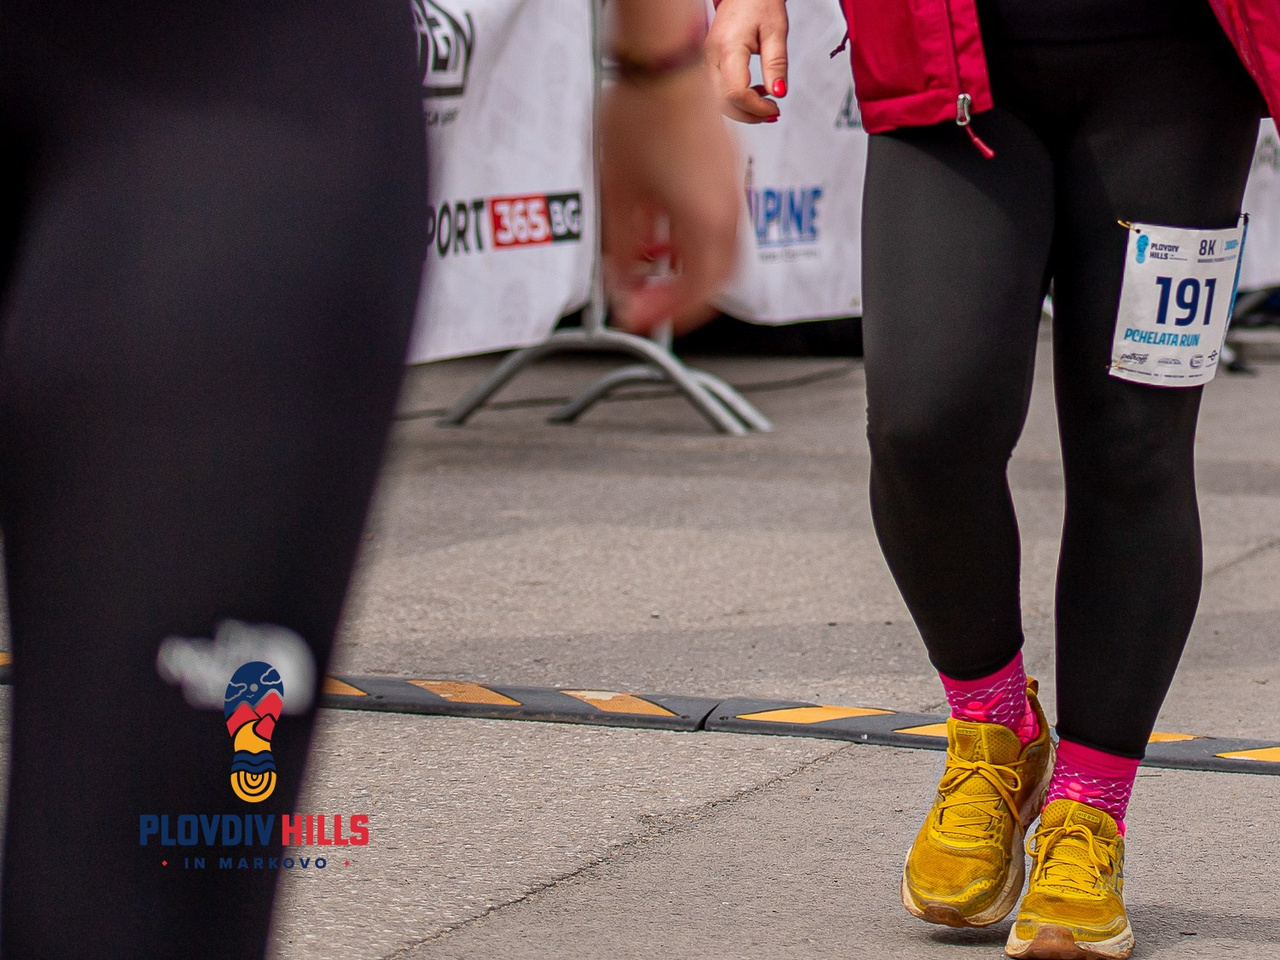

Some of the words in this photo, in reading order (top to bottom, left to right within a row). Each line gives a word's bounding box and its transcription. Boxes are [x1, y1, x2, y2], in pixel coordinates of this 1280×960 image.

[1149, 251, 1169, 260] HILLS
[1198, 239, 1217, 256] 8K
[1155, 275, 1218, 327] 191
[1123, 327, 1179, 347] PCHELATA
[1179, 333, 1201, 347] RUN
